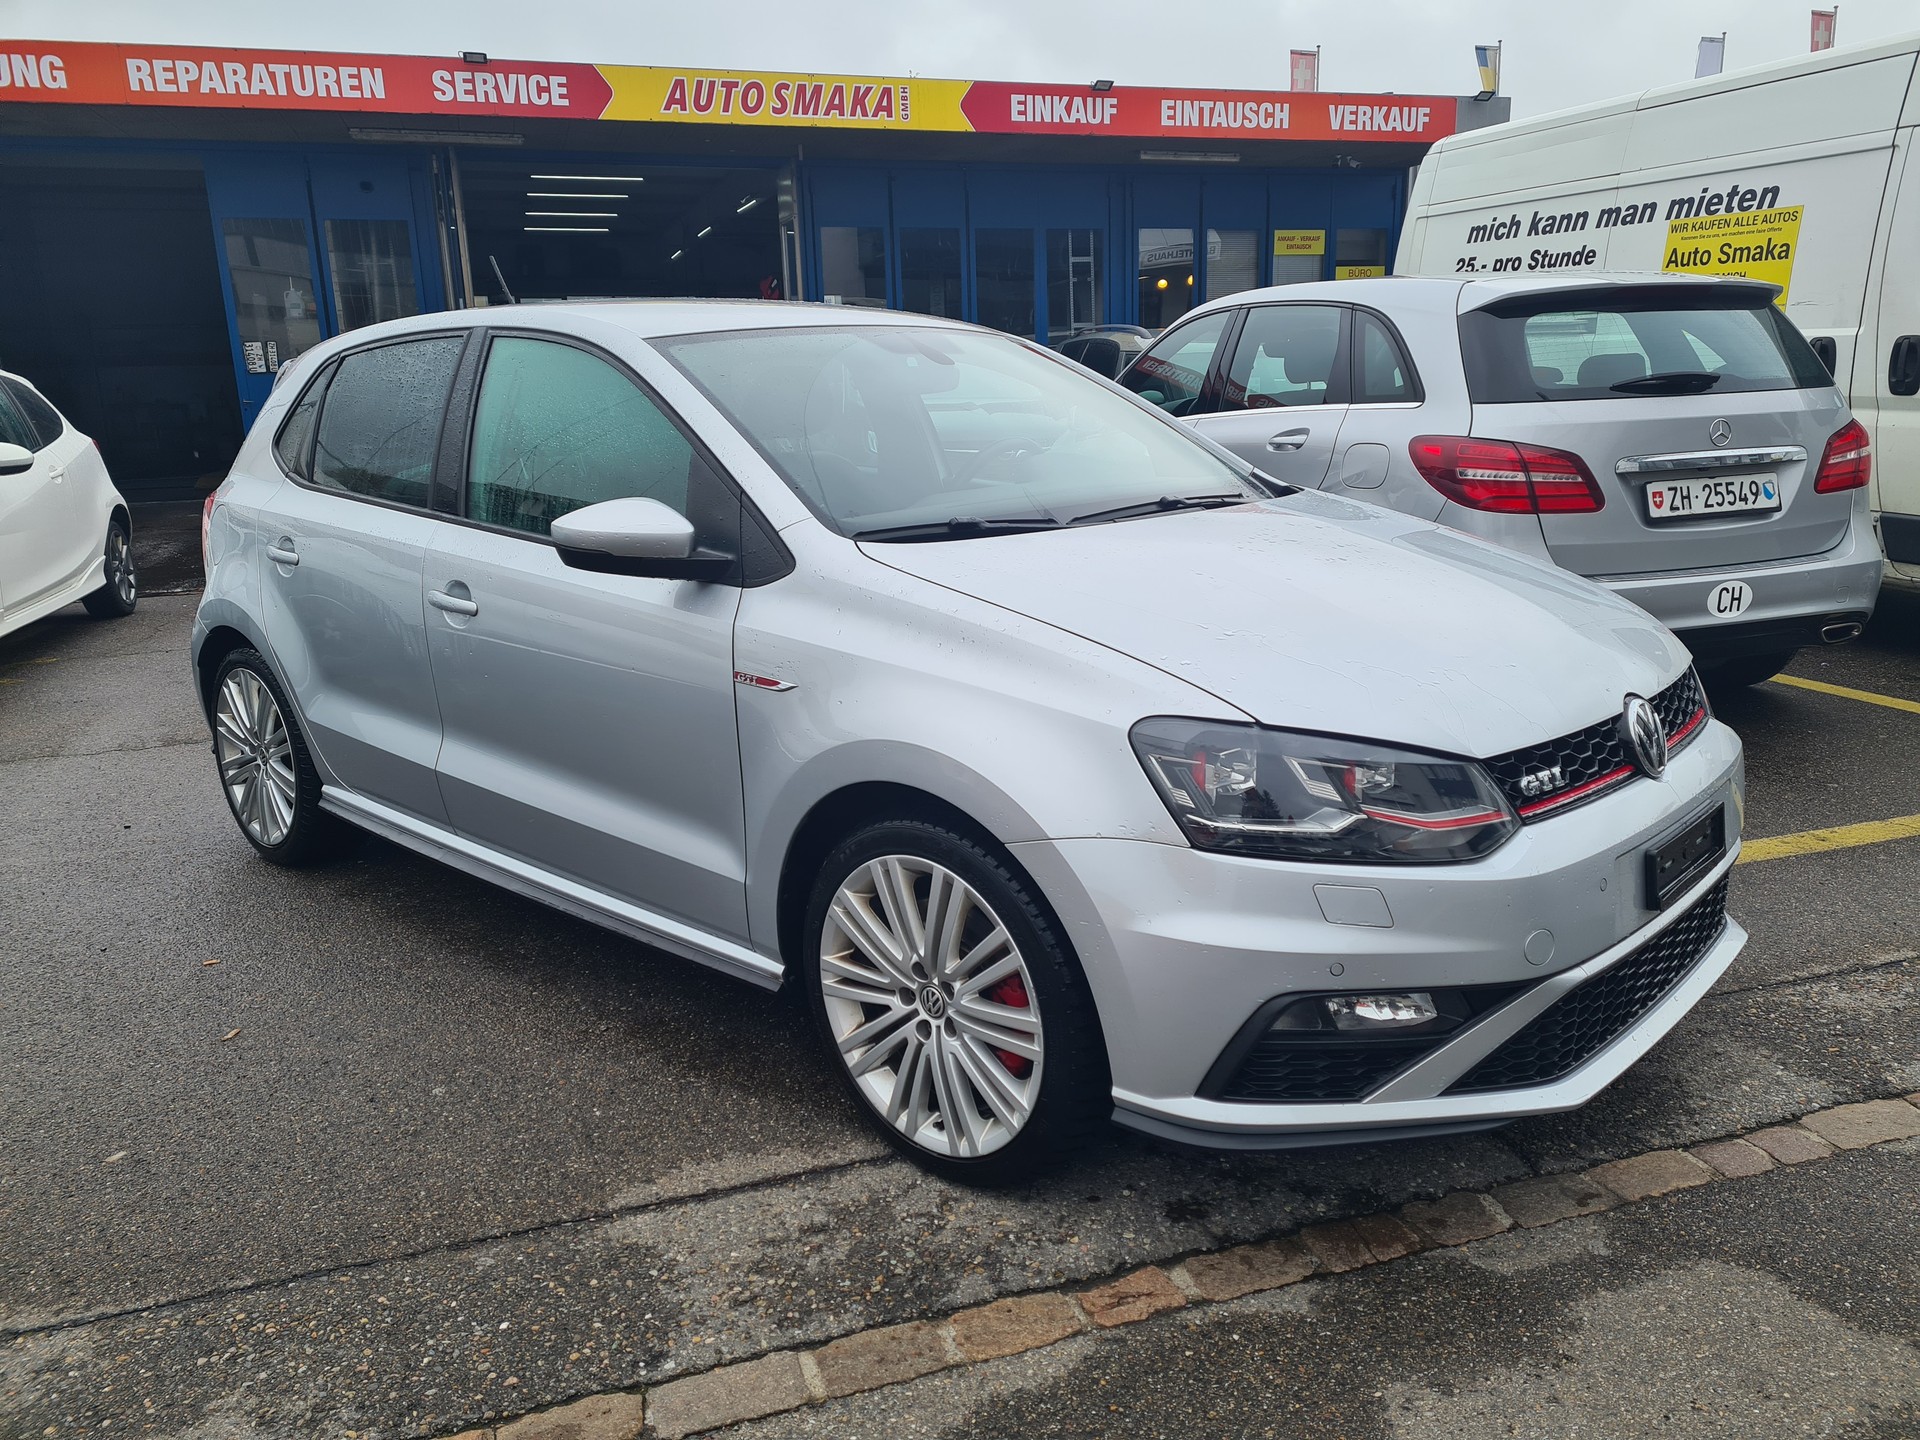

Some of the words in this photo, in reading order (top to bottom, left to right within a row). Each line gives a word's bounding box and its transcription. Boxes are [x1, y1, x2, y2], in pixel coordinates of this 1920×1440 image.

[126, 58, 386, 99] REPARATUREN
[432, 70, 570, 107] SERVICE
[661, 77, 767, 116] AUTO
[769, 80, 897, 121] SMAKA
[900, 86, 909, 121] GMBH
[1010, 94, 1118, 125] EINKAUF
[1160, 99, 1290, 130] EINTAUSCH
[1328, 105, 1430, 133] VERKAUF
[1466, 214, 1522, 244] mich
[1526, 210, 1589, 237] kann
[1595, 201, 1658, 229] man
[1665, 185, 1780, 221] mieten
[1671, 223, 1689, 234] WIR
[1691, 218, 1732, 232] KAUFEN
[1733, 214, 1760, 228] ALLE
[1761, 210, 1799, 225] AUTOS
[1527, 244, 1597, 271] Stunde
[1665, 247, 1712, 269] Auto
[1717, 237, 1791, 265] Smaka
[1348, 268, 1372, 278] BÜRO
[1716, 586, 1743, 613] CH
[1520, 766, 1567, 797] GTI
